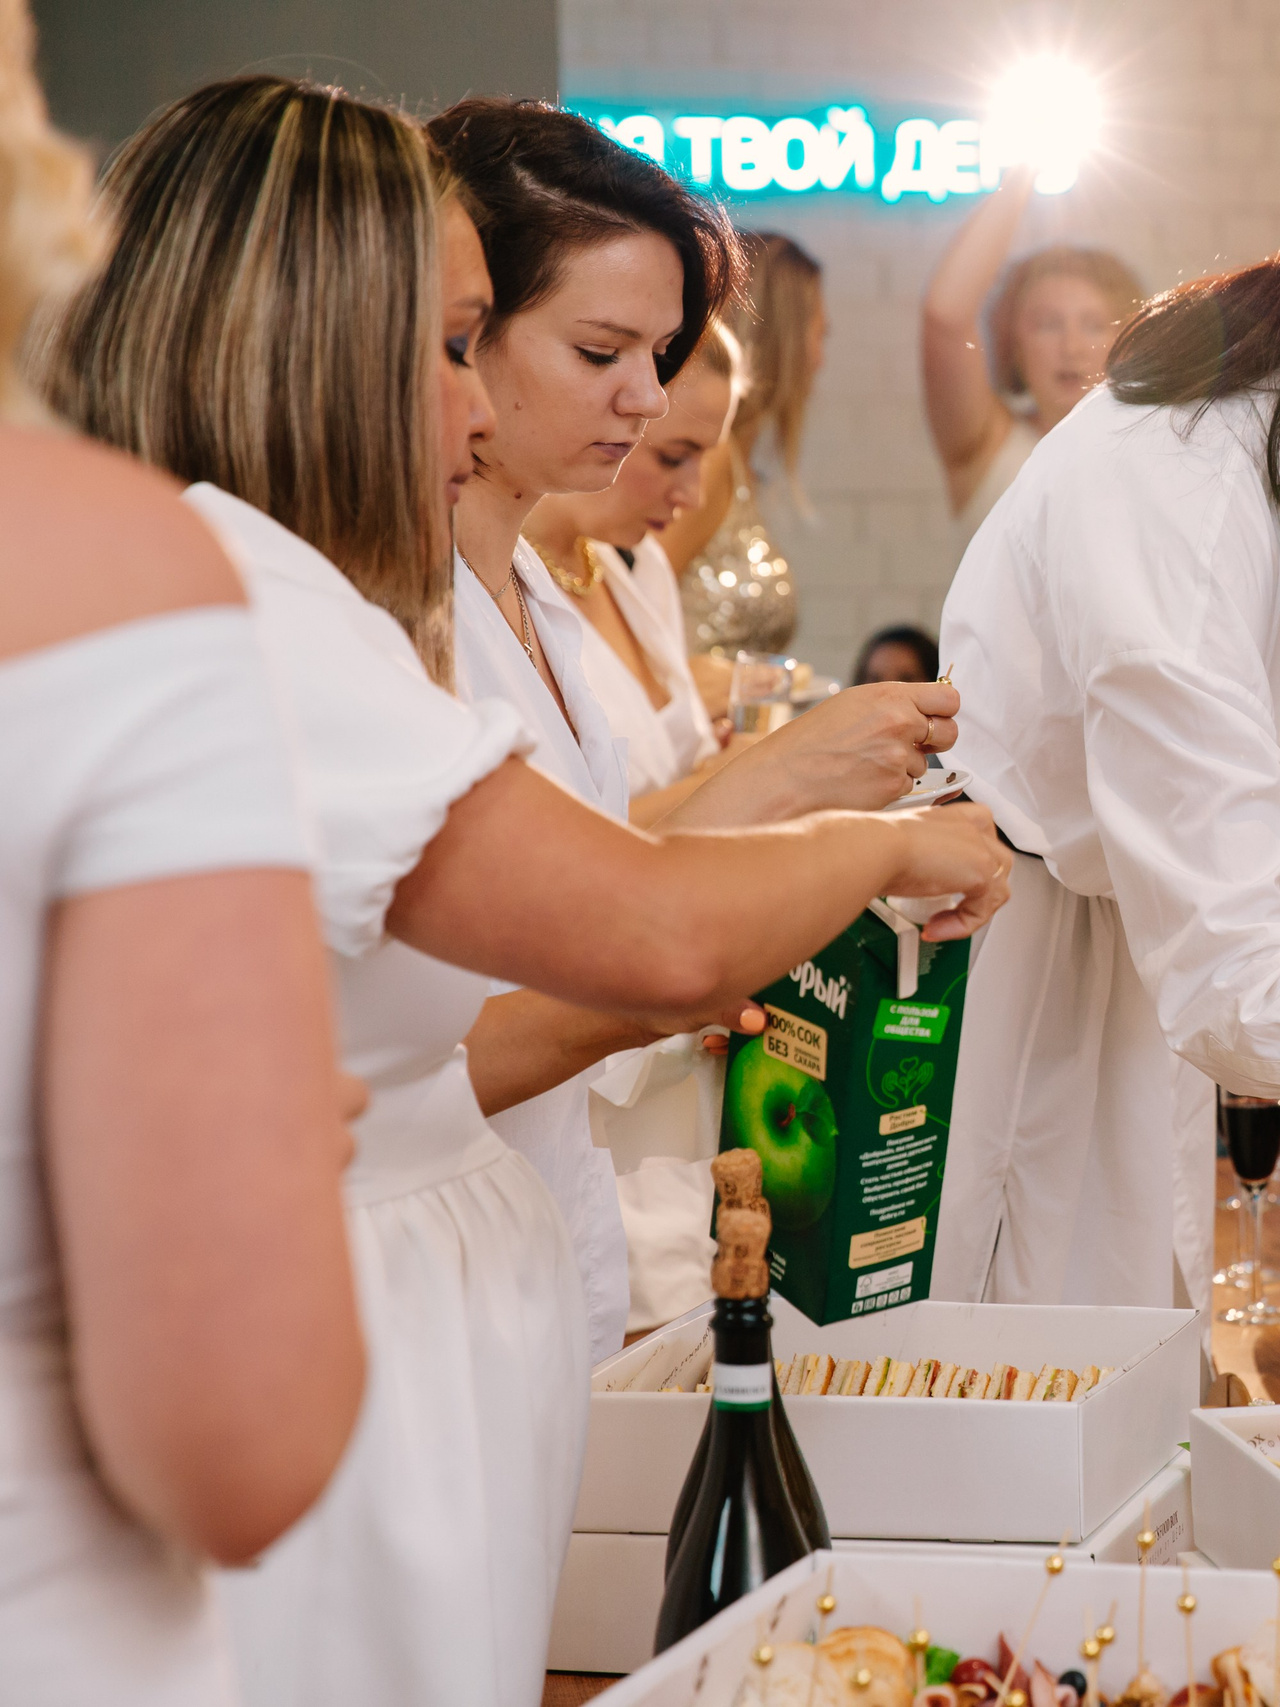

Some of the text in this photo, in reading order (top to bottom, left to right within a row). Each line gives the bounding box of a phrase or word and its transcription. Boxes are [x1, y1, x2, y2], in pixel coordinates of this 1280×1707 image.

[674, 105, 874, 191] ТВОЙ
[768, 1036, 789, 1058] БЕЗ
[797, 1026, 821, 1050] СОК
